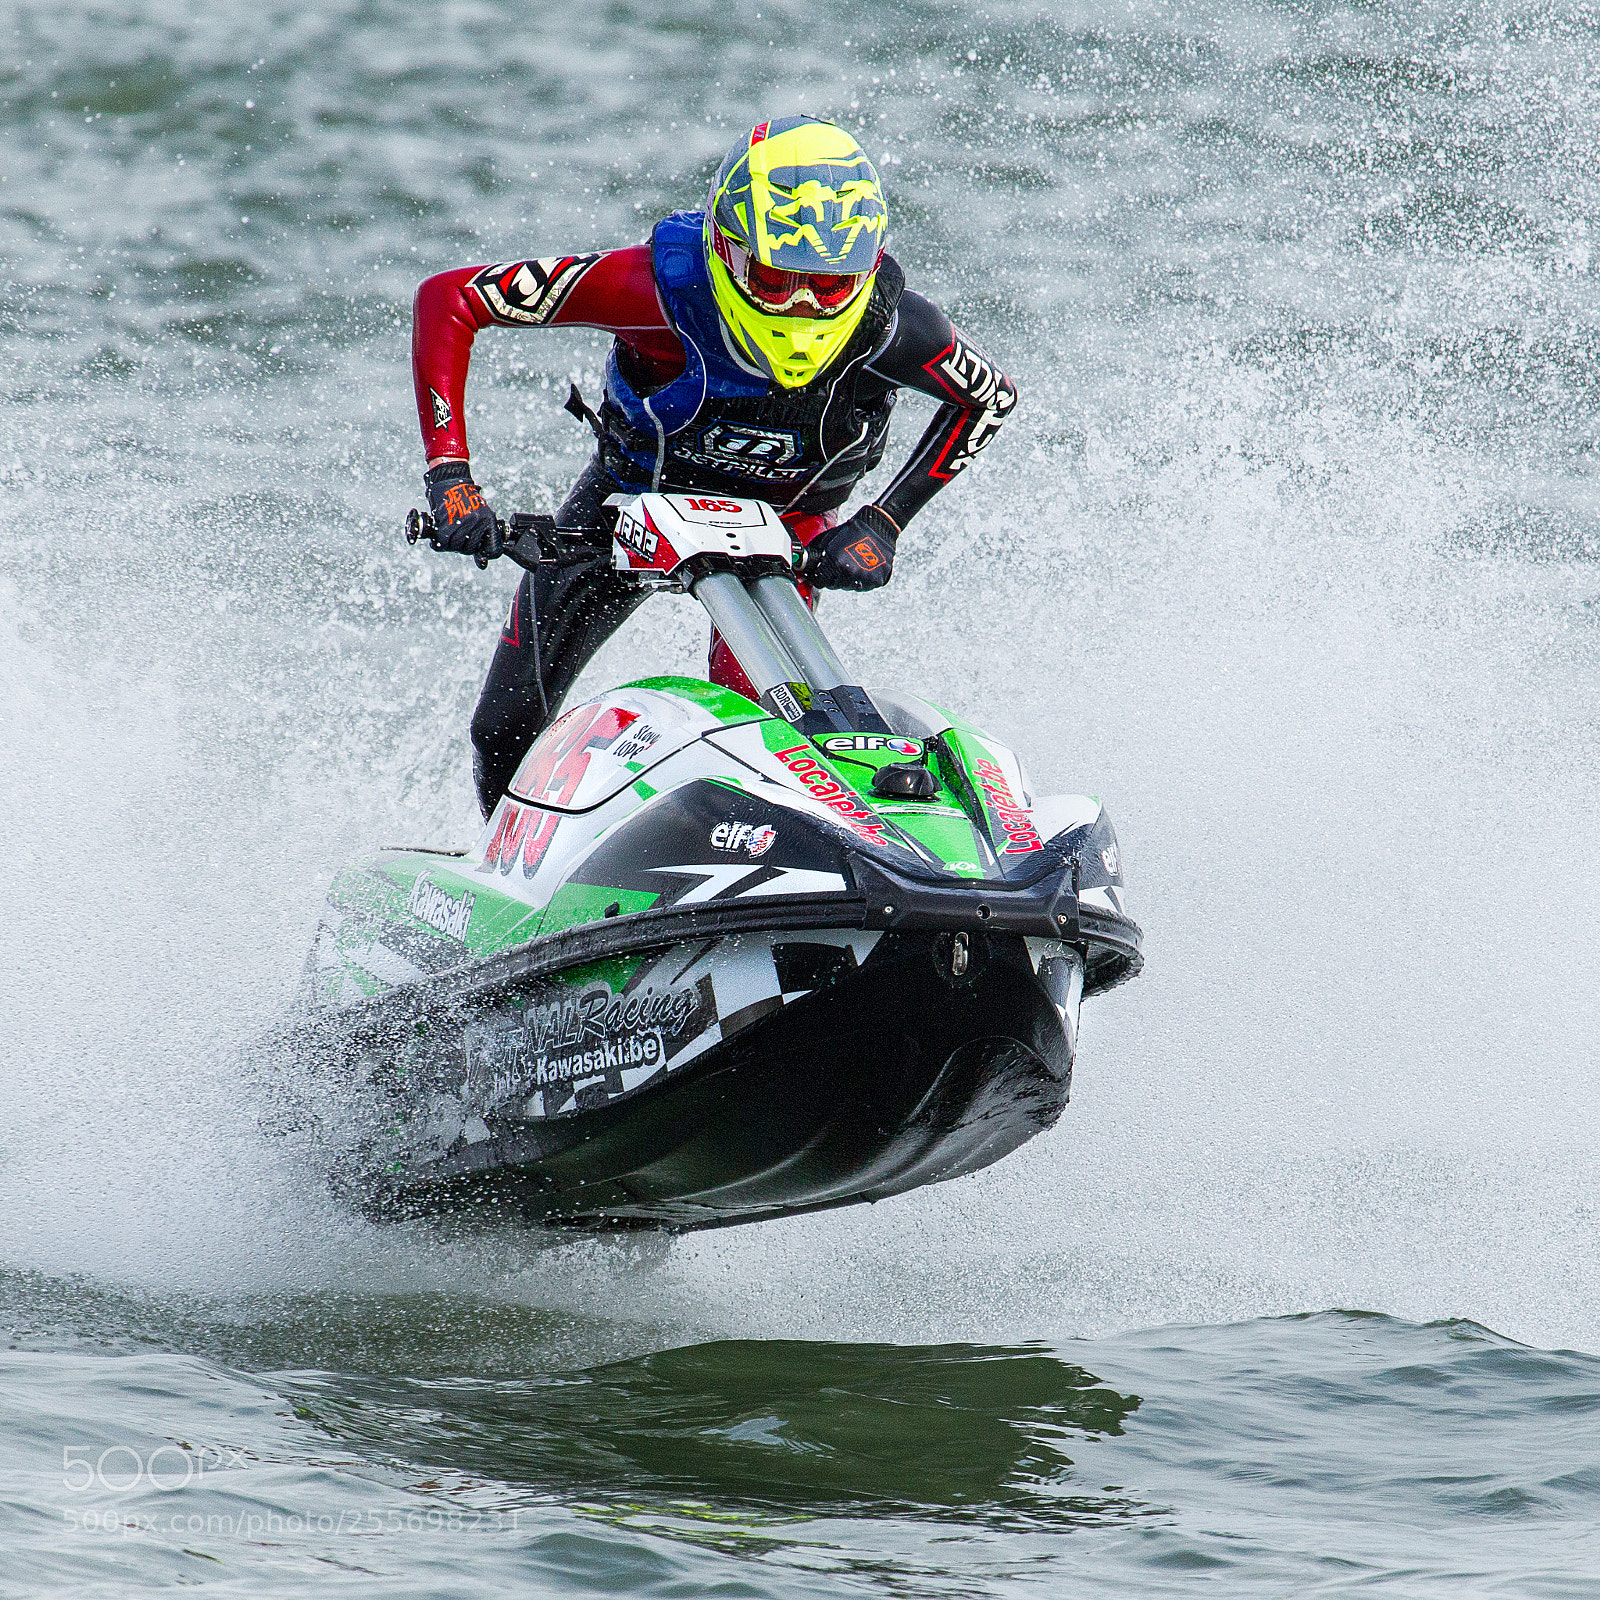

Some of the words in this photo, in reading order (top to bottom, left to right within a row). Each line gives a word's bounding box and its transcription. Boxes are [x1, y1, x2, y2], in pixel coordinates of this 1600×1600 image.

[684, 497, 743, 513] 165
[825, 736, 886, 751] elf
[972, 757, 1044, 855] Locajet.be
[710, 821, 754, 852] elf
[407, 868, 477, 944] Kawasaki
[579, 987, 700, 1037] Racing
